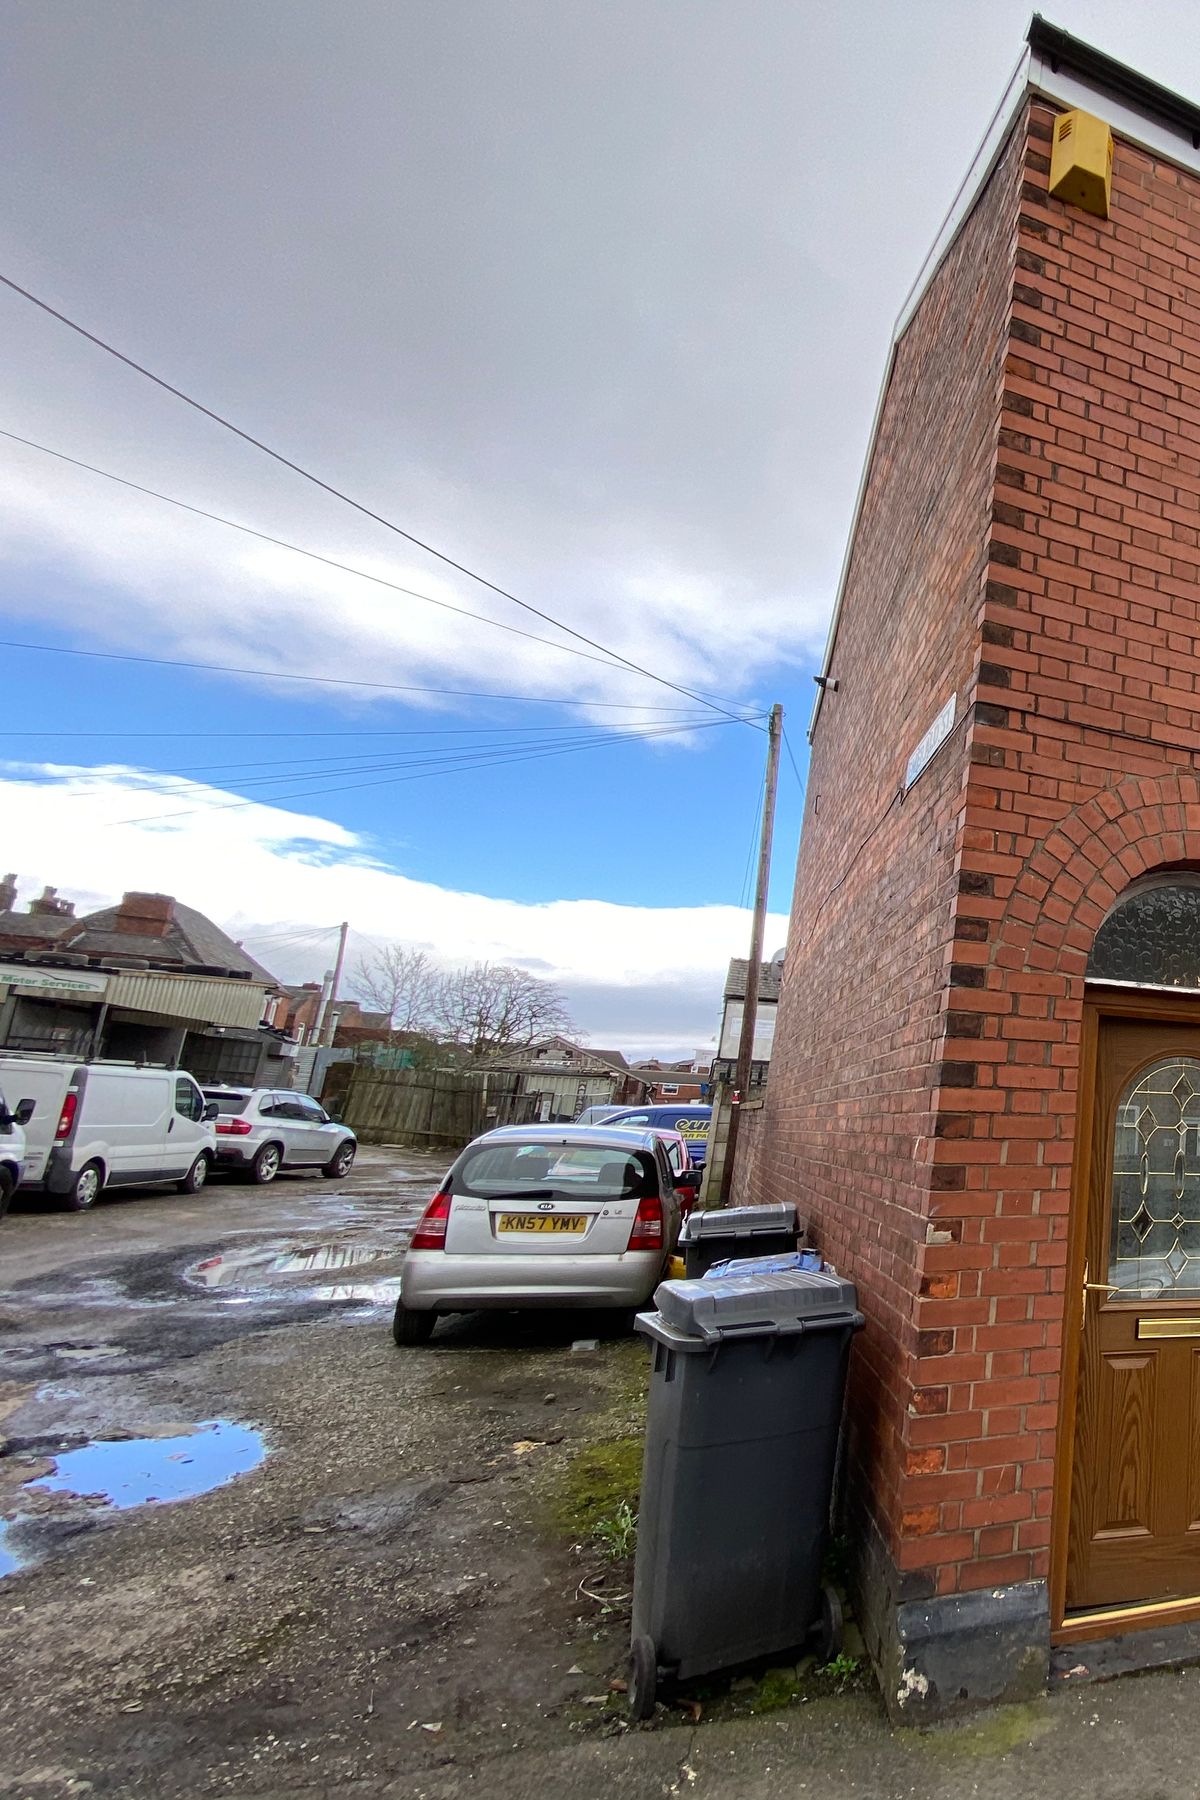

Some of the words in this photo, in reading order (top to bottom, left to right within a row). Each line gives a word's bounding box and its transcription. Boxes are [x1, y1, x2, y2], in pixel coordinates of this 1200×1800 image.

[2, 975, 38, 985] Motor
[41, 978, 91, 990] Services
[504, 1216, 546, 1230] KN57
[551, 1216, 581, 1230] YMV
